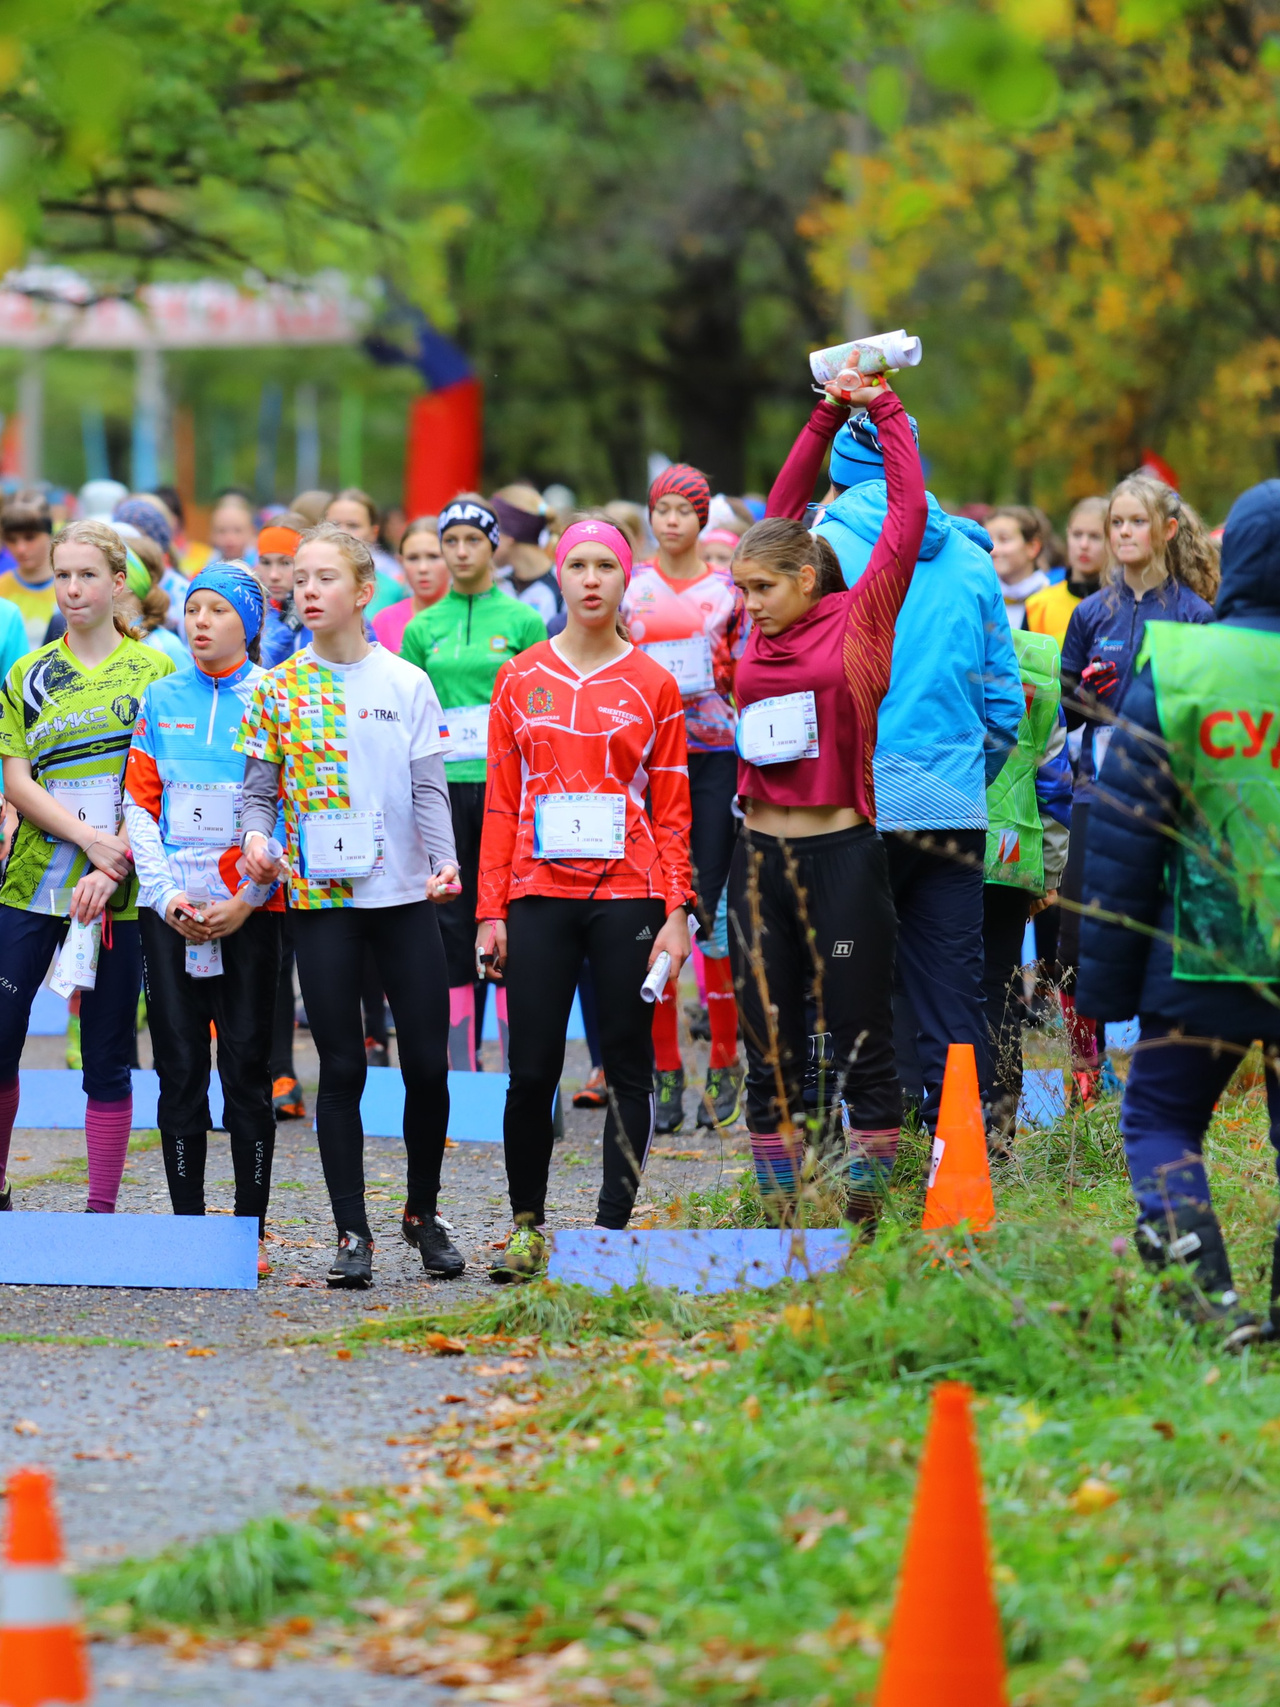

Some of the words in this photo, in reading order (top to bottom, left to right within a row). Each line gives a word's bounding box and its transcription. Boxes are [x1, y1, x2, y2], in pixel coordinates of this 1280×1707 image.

[669, 660, 684, 673] 27
[462, 728, 478, 740] 28
[769, 724, 774, 738] 1
[78, 807, 86, 821] 6
[193, 808, 202, 823] 5
[571, 819, 581, 834] 3
[334, 837, 343, 852] 4
[196, 965, 209, 973] 5.2
